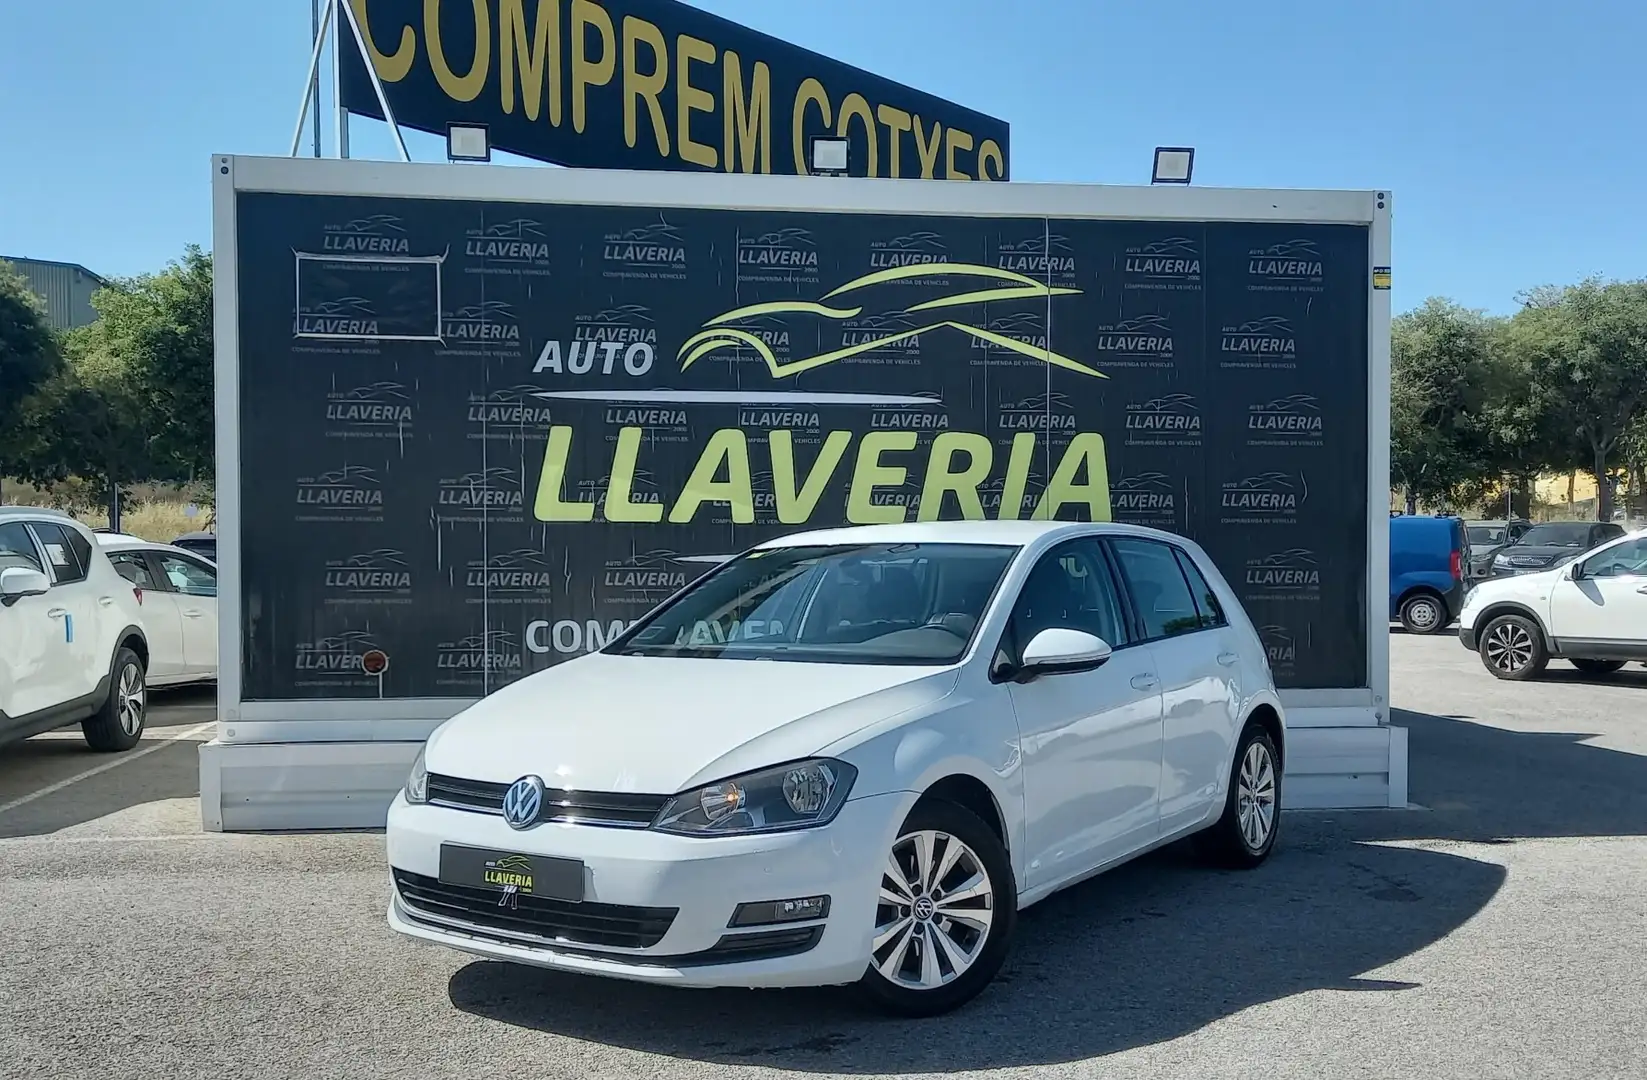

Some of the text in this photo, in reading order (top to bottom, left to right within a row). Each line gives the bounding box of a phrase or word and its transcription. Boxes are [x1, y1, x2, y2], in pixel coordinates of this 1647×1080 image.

[349, 0, 770, 174] COMPREM
[324, 237, 408, 252] LLAVERIA
[466, 242, 548, 257] LLAVERIA
[604, 246, 685, 261] LLAVERIA
[739, 250, 817, 264] LLAVERIA
[870, 254, 948, 268] LLAVERIA
[999, 256, 1074, 270] LLAVERIA
[1126, 259, 1200, 272] LLAVERIA
[1249, 261, 1322, 274] LLAVERIA
[575, 327, 656, 342] LLAVERIA
[970, 335, 1046, 349] LLRIA
[1098, 337, 1172, 350] LLAVERIA
[1222, 338, 1294, 352] LLAVERIA
[532, 340, 654, 376] AUTO
[326, 405, 411, 420] LLAVERIA
[468, 407, 550, 422] LLAVERIA
[606, 409, 686, 424] LLAVERIA
[740, 412, 819, 426] LLAVERIA
[871, 413, 948, 428] LLAVERIA
[999, 414, 1075, 428] LLAVERIA
[1126, 415, 1200, 429] LLAVERIA
[1249, 415, 1321, 430] LLAVERIA
[533, 426, 1112, 523] LLAVERIA
[297, 489, 382, 504] LLAVERIA
[439, 490, 522, 505] LLAVERIA
[844, 494, 920, 507] VERIA
[1110, 493, 1174, 508] LAVERIA
[1222, 493, 1295, 507] LLAVERIA
[326, 571, 410, 587] LLAVERIA
[467, 571, 549, 587] LLAVERIA
[605, 571, 685, 587] LLAVERIA
[1246, 570, 1319, 584] LLAVERIA
[296, 654, 363, 670] LLAVER
[437, 653, 520, 669] LLAVERIA
[484, 870, 532, 887] LLAVERIA
